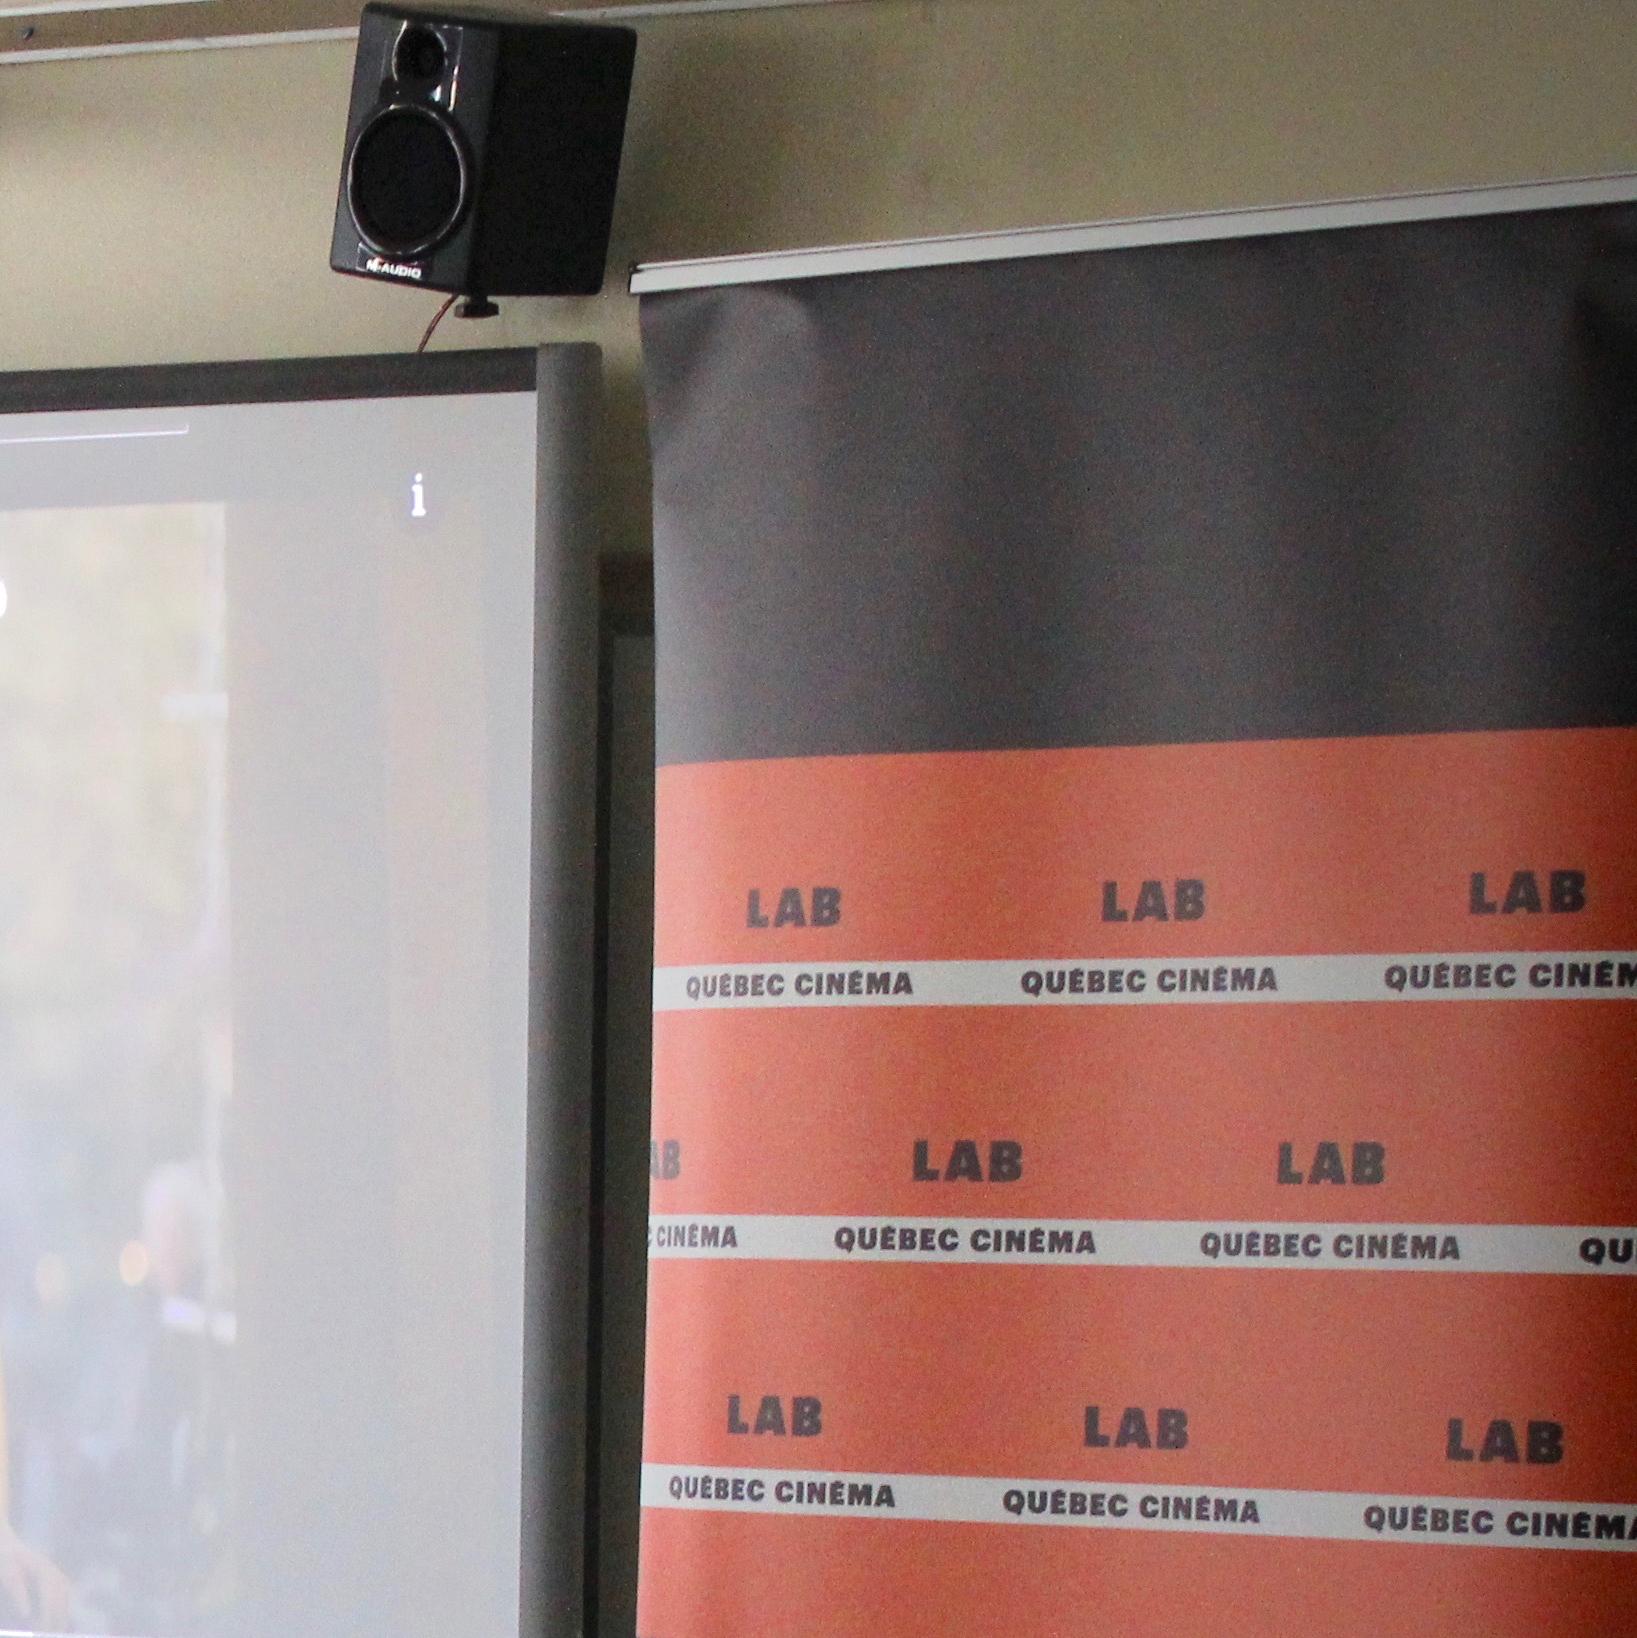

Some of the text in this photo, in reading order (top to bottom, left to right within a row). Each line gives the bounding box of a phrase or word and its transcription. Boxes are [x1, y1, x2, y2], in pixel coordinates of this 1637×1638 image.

[366, 258, 422, 280] M-AUDIO
[746, 886, 842, 928] LAB
[1101, 878, 1205, 923] LAB
[1470, 868, 1588, 915] LAB
[687, 970, 913, 999] QUÉBEC CINÉMA
[1021, 966, 1277, 996] QUÉBEC CINÉMA
[1386, 962, 1517, 991] QUÉBEC
[912, 1139, 1022, 1183] LAB
[1276, 1141, 1385, 1186] LAB
[656, 1224, 738, 1248] CINÉMA
[835, 1225, 1096, 1253] QUÉBEC CINÉMA
[1201, 1231, 1461, 1260] QUÉBEC CINÉMA
[726, 1394, 822, 1438] LAB
[1083, 1405, 1188, 1450] LAB
[1447, 1419, 1565, 1466] LAB
[670, 1475, 895, 1508] QUÉBEC CINÉMA
[1003, 1489, 1260, 1523] QUÉBEC CINÉMA
[1365, 1505, 1494, 1535] QUÉBEC
